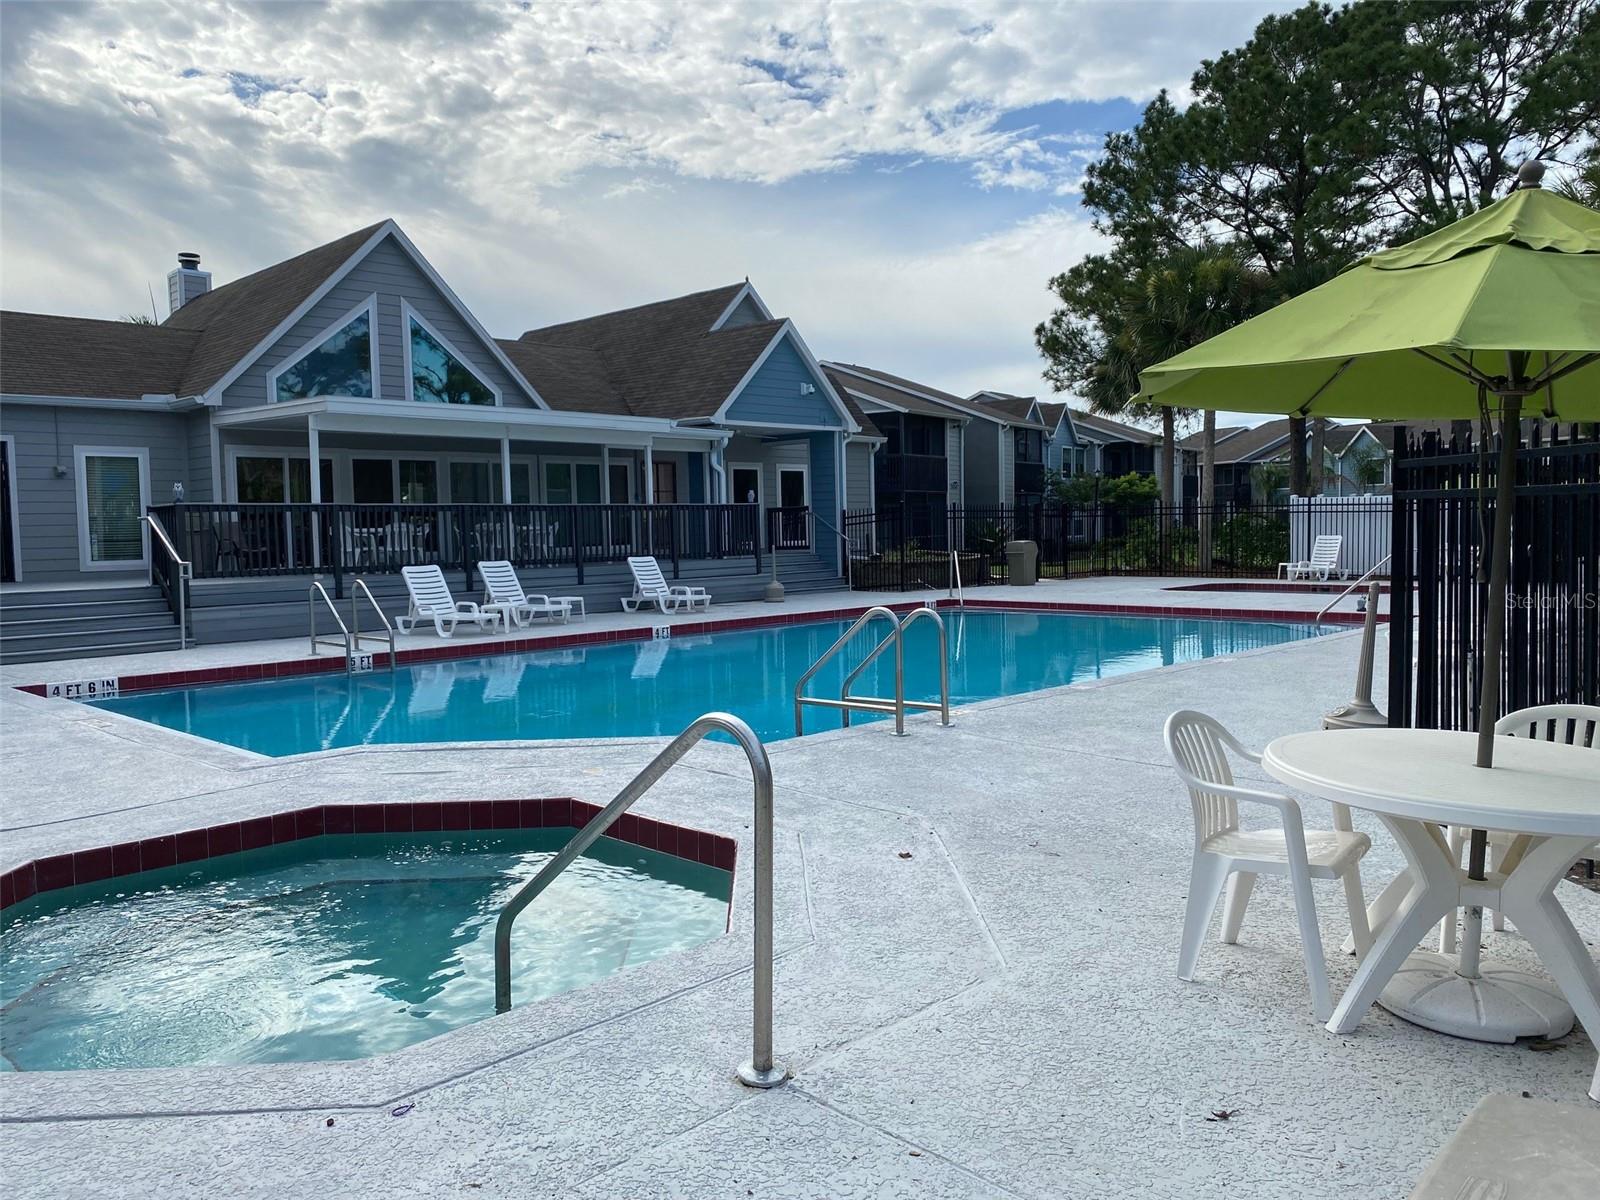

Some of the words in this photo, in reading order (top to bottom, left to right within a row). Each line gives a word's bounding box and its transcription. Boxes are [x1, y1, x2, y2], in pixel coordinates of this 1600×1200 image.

[361, 656, 371, 665] FT
[52, 686, 60, 696] 4
[66, 684, 81, 695] FT
[88, 682, 96, 693] 6
